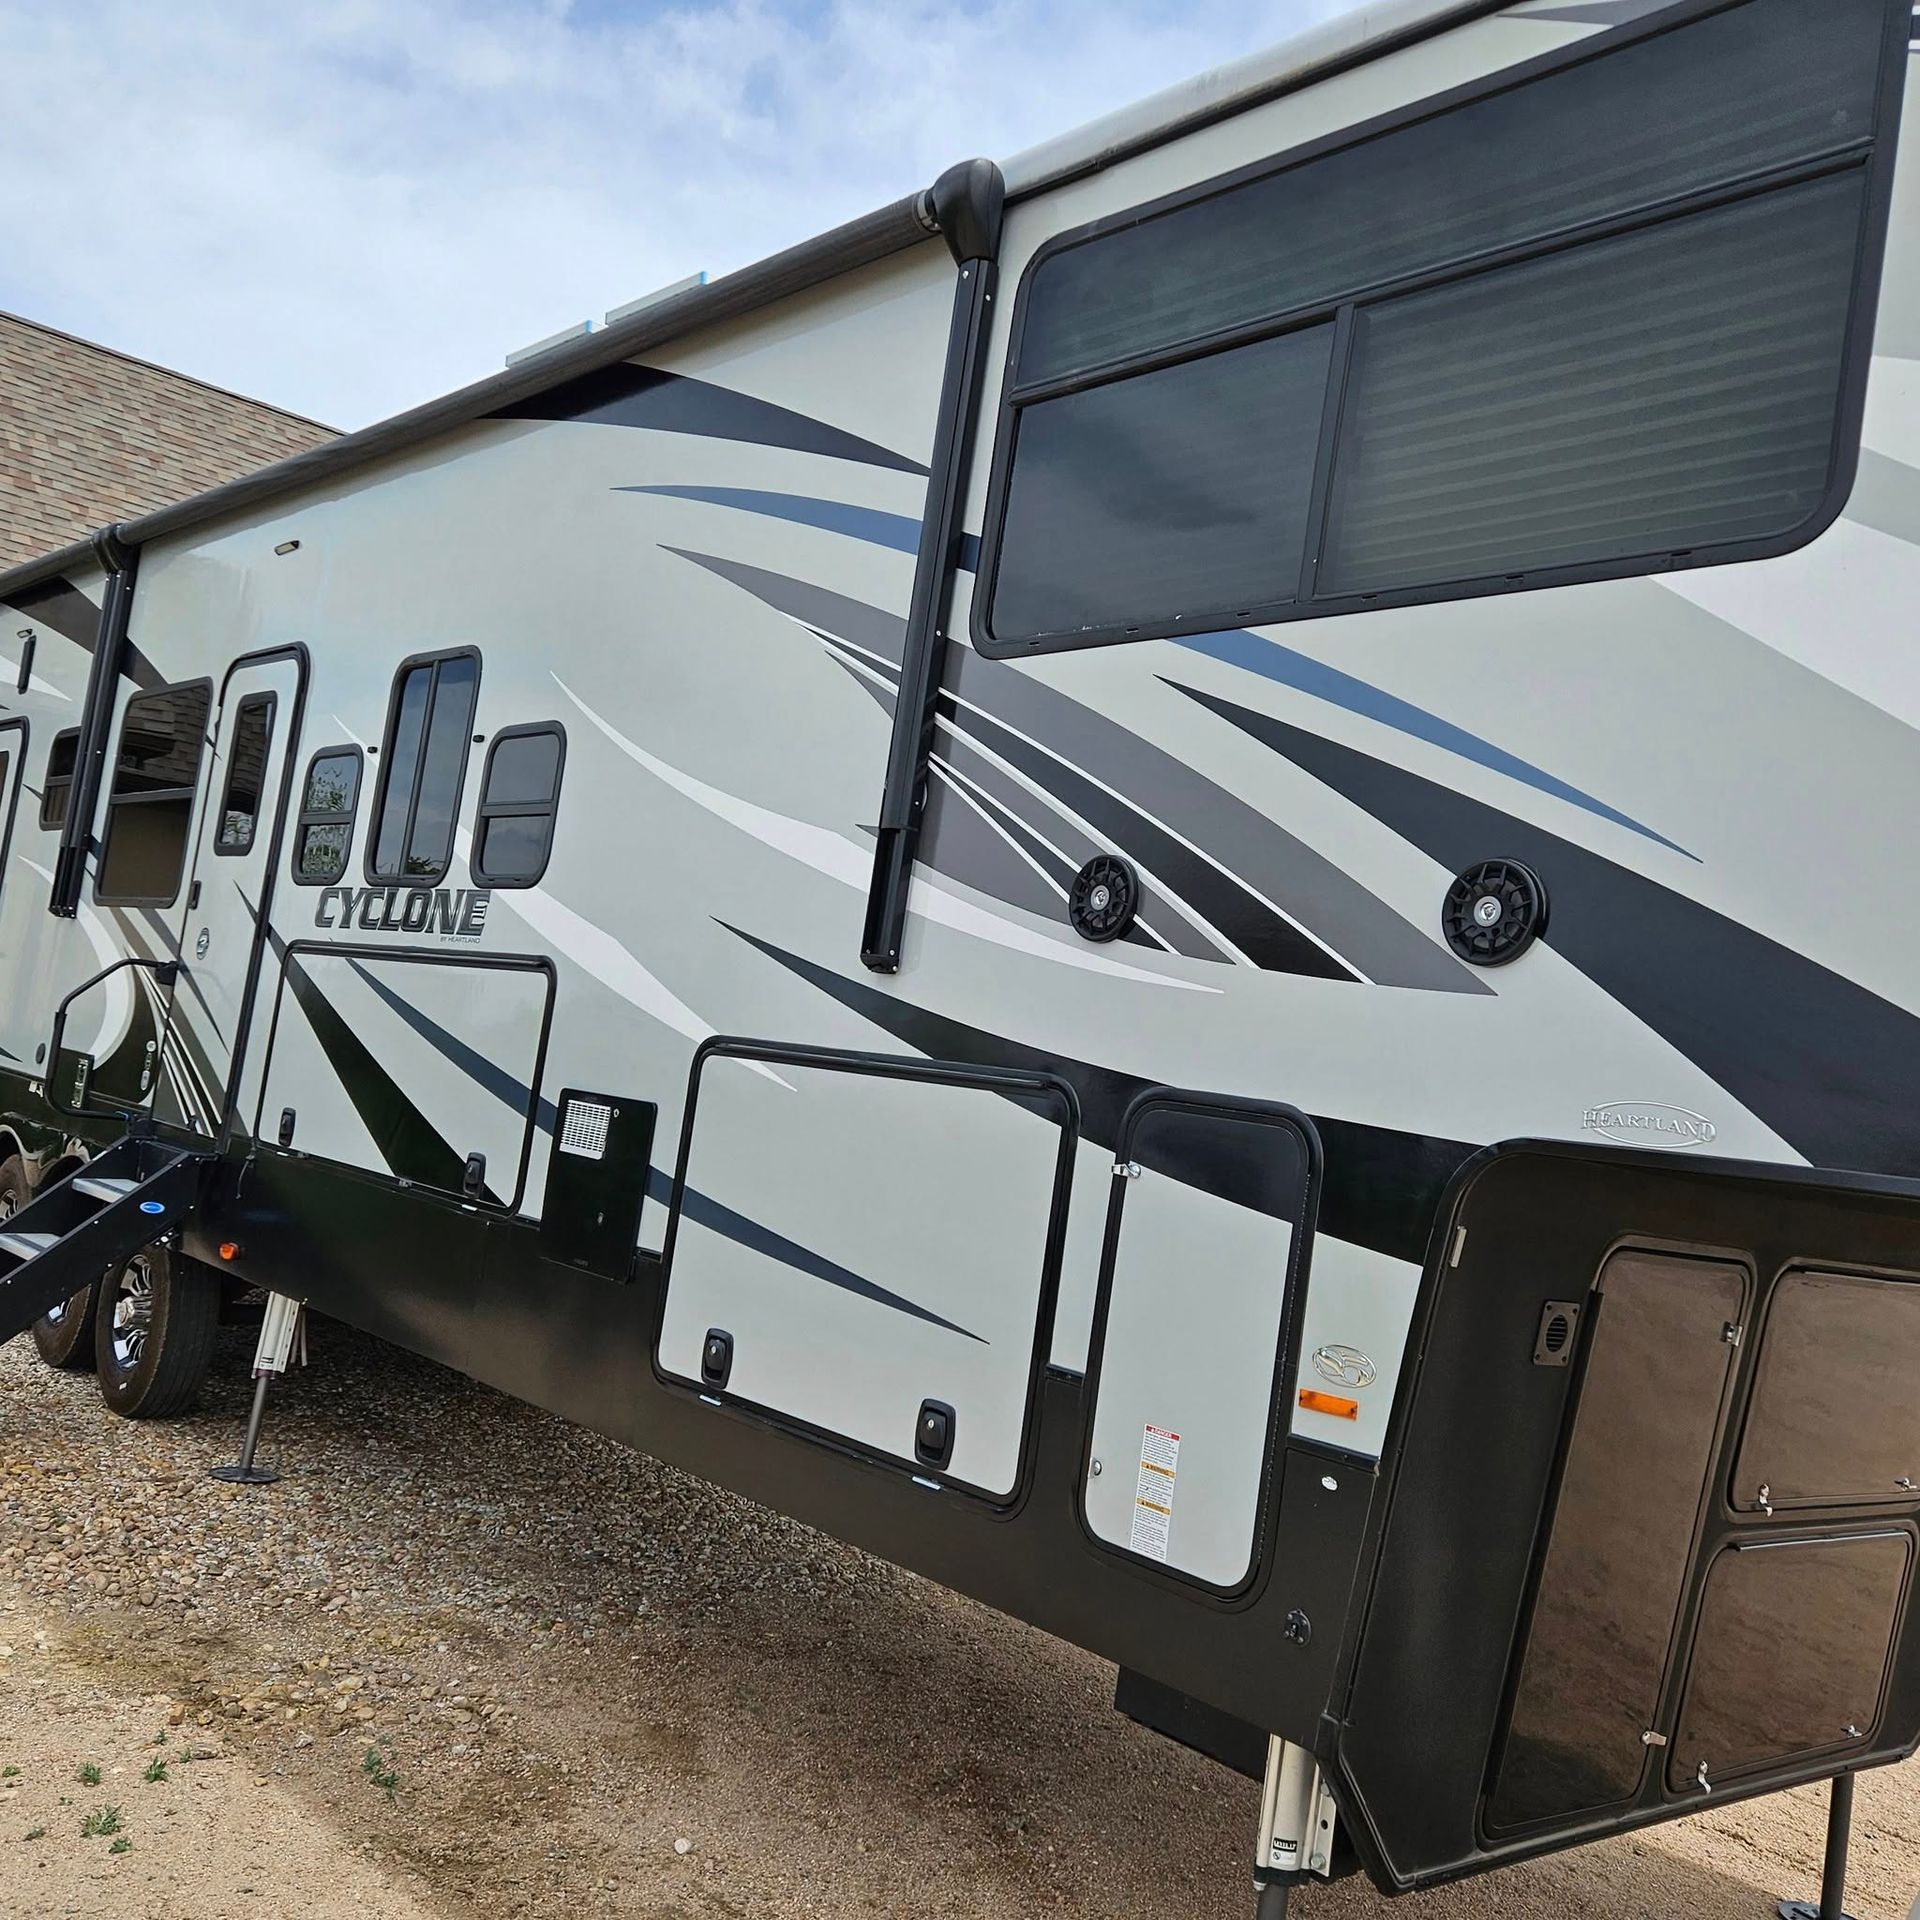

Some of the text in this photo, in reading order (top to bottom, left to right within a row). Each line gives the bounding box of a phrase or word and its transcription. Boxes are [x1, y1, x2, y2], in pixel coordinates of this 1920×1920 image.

[314, 887, 491, 936] CYCLONE
[448, 936, 481, 944] HEARTLAND
[1581, 1109, 1717, 1142] HEARTLAND
